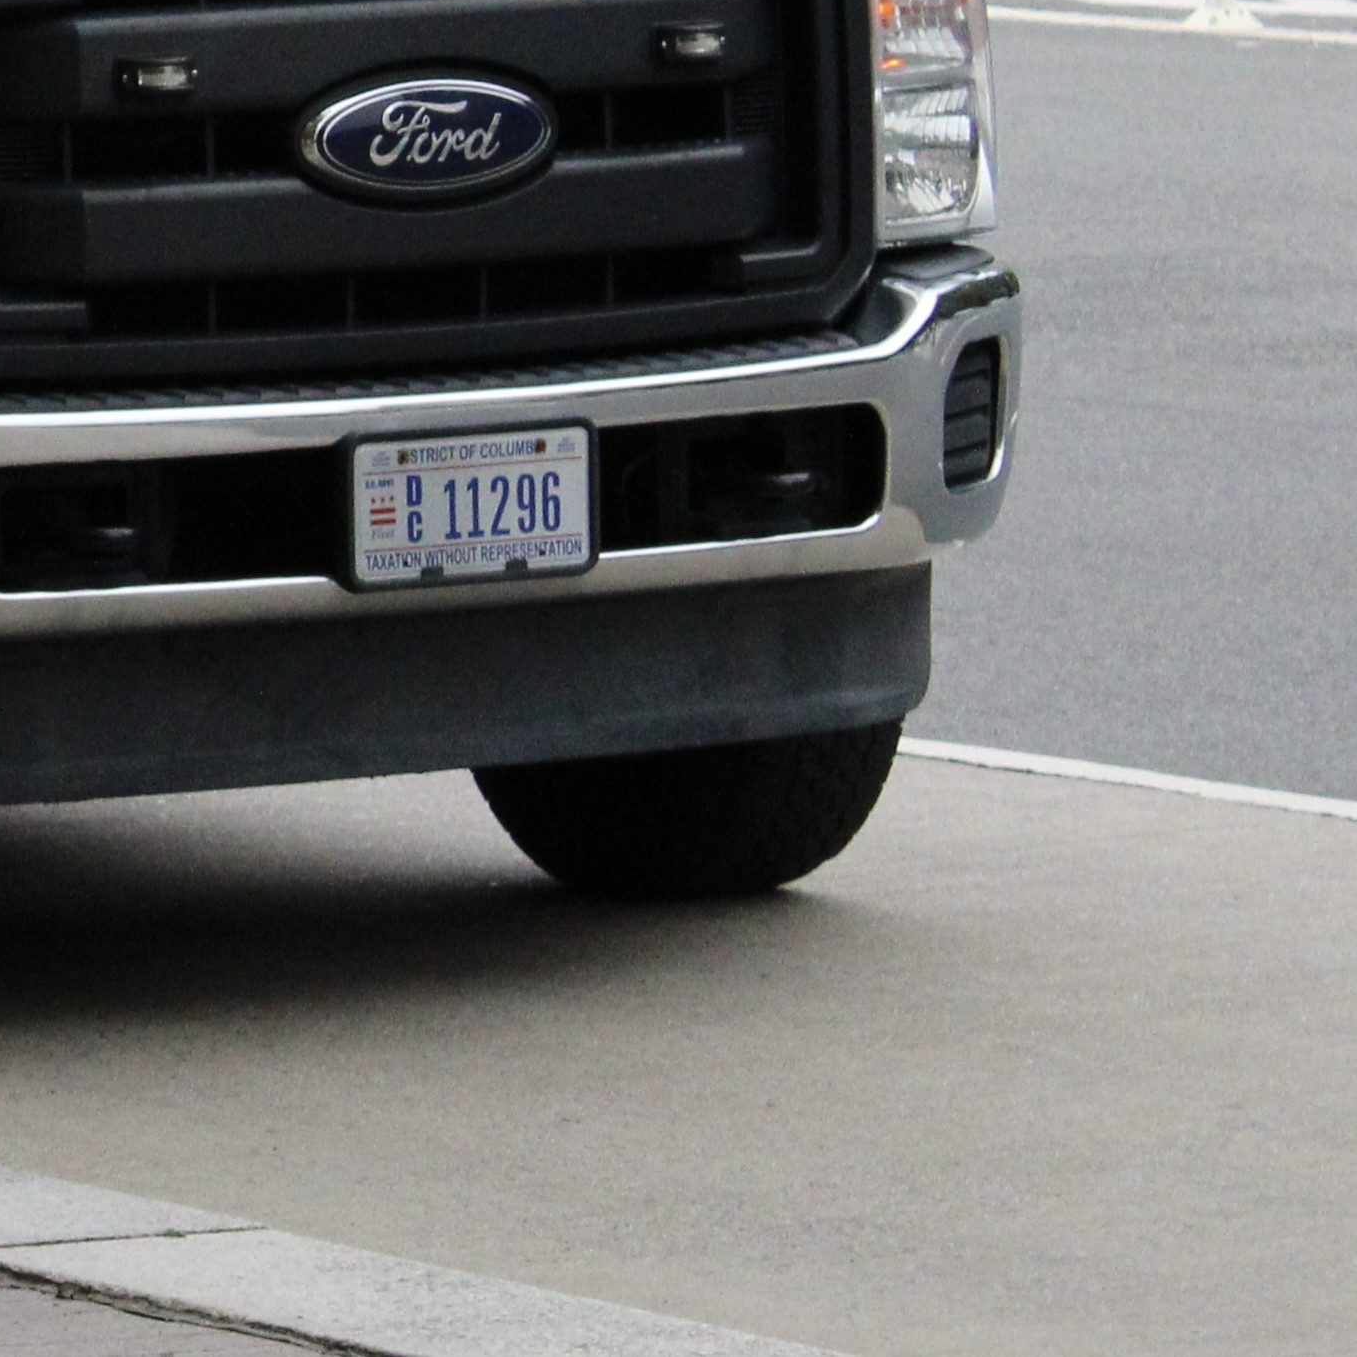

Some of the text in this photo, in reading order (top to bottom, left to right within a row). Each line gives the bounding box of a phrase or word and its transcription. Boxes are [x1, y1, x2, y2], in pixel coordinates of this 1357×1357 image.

[370, 100, 502, 166] Ford
[397, 446, 455, 465] STRICT
[459, 445, 475, 460] OF
[480, 439, 546, 458] COLUMB
[443, 471, 561, 540] 11296
[366, 539, 583, 571] TAXATION WITHOUT REPRESENTATION
